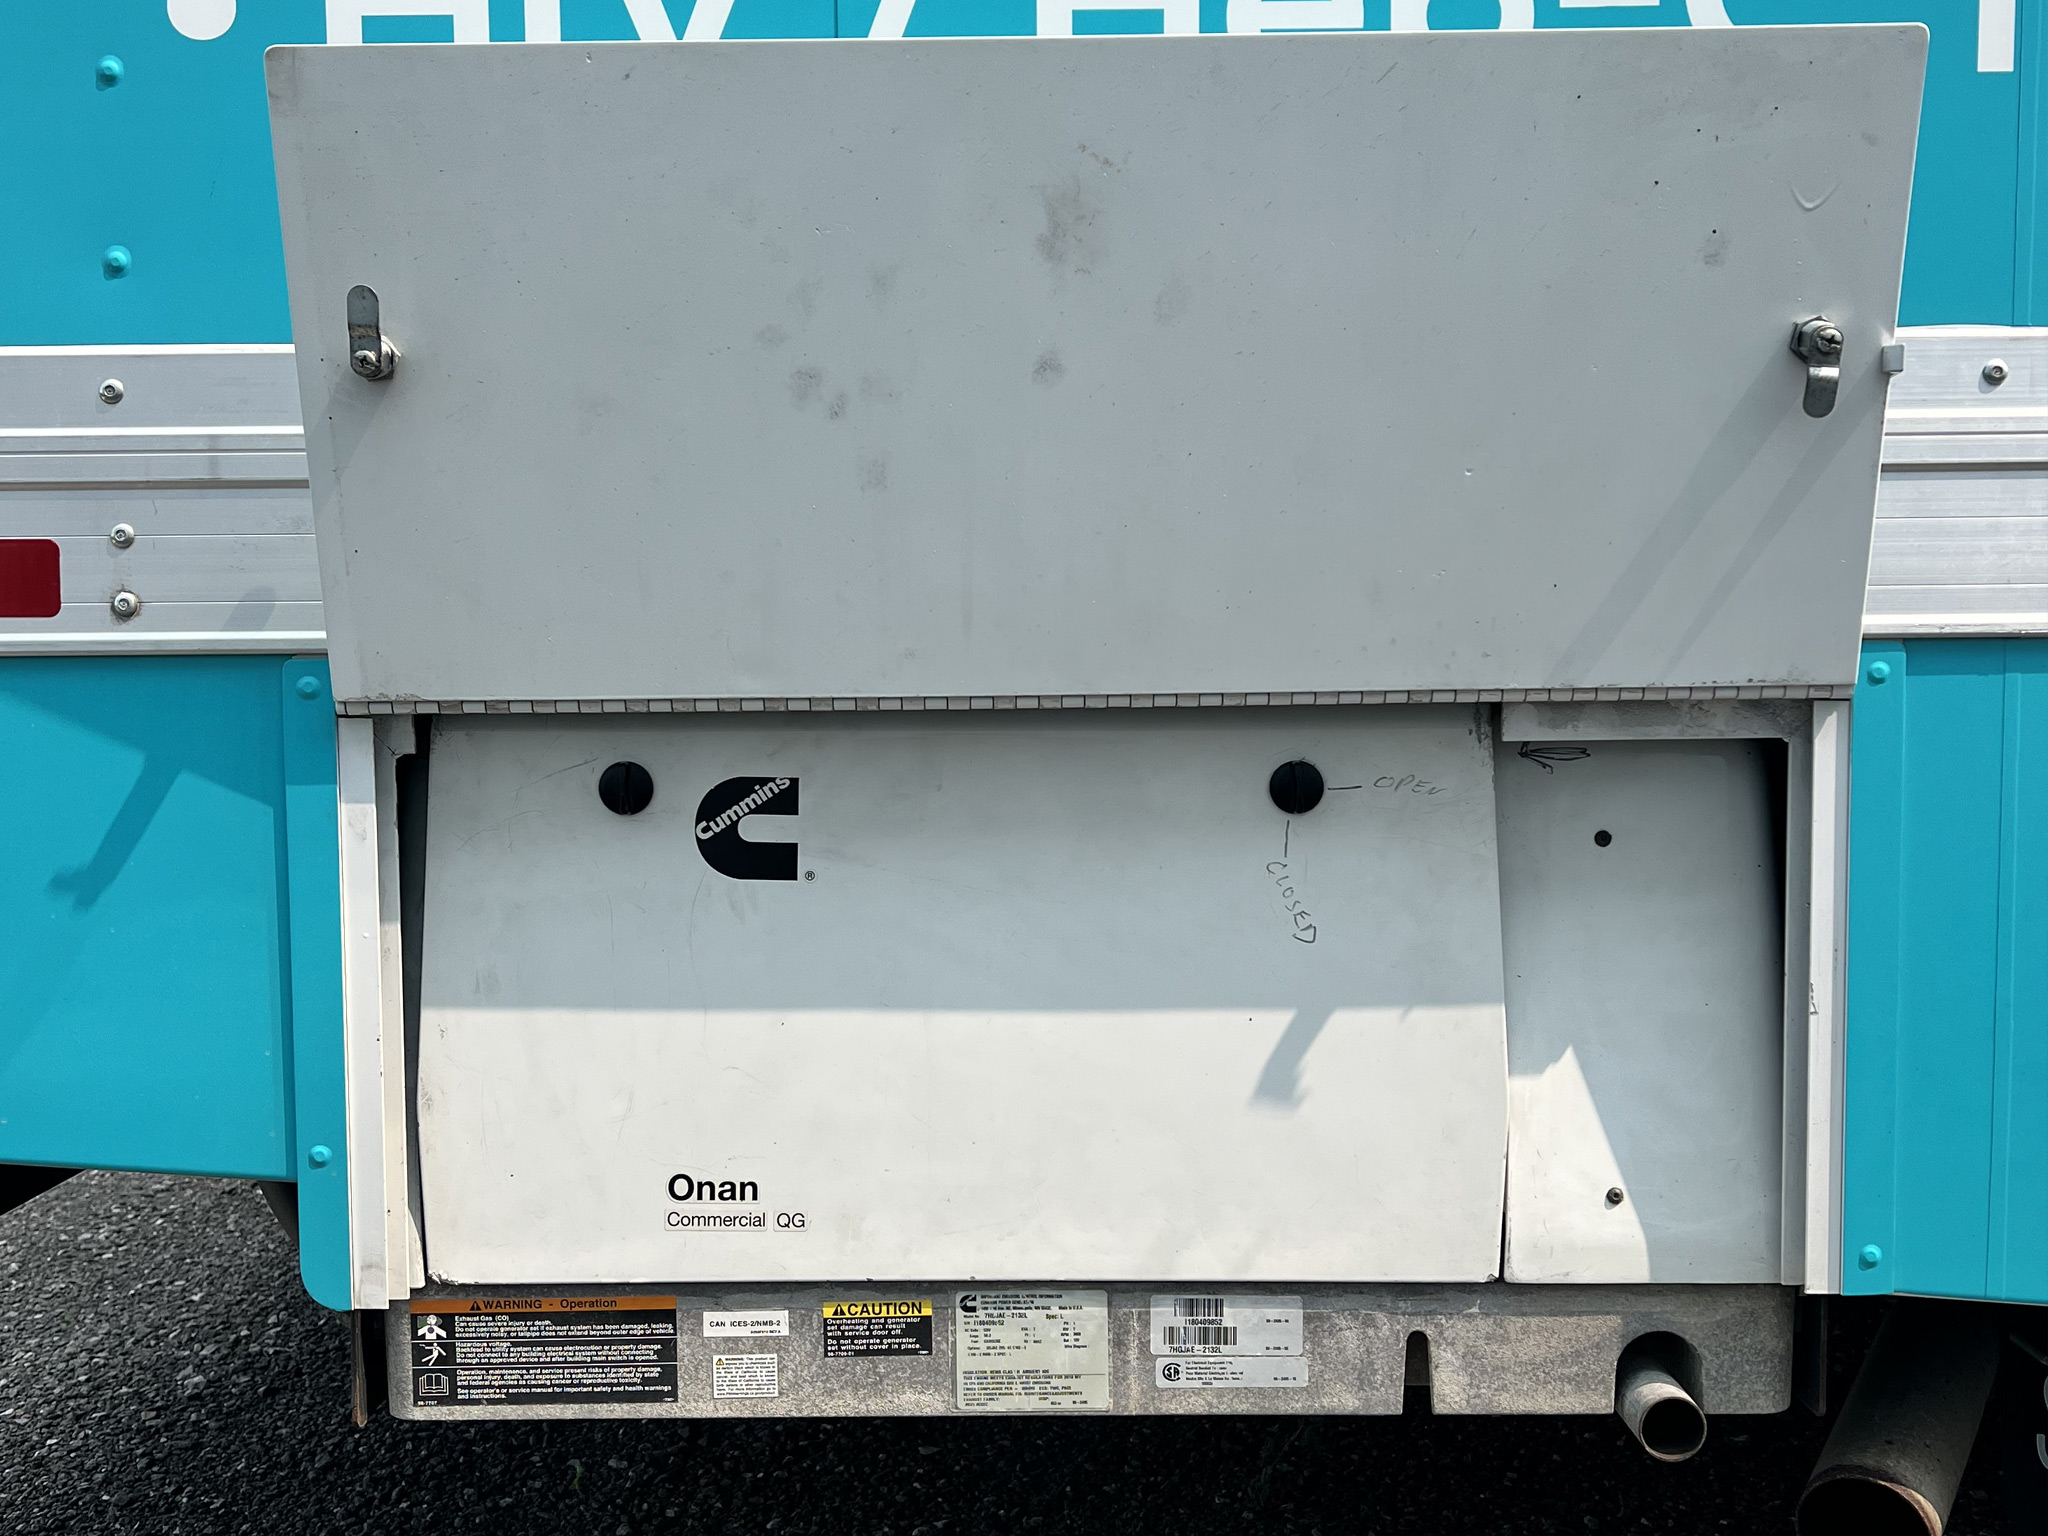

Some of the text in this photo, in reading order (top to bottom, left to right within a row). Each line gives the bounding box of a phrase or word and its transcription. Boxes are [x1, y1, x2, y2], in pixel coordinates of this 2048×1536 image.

[696, 776, 791, 841] Cummins
[1266, 861, 1317, 944] CLOSED
[668, 1174, 758, 1202] Onan
[667, 1211, 806, 1228] Commercial QG
[482, 1300, 542, 1310] WARNING
[560, 1298, 618, 1310] Operation
[848, 1302, 922, 1316] CAUTION
